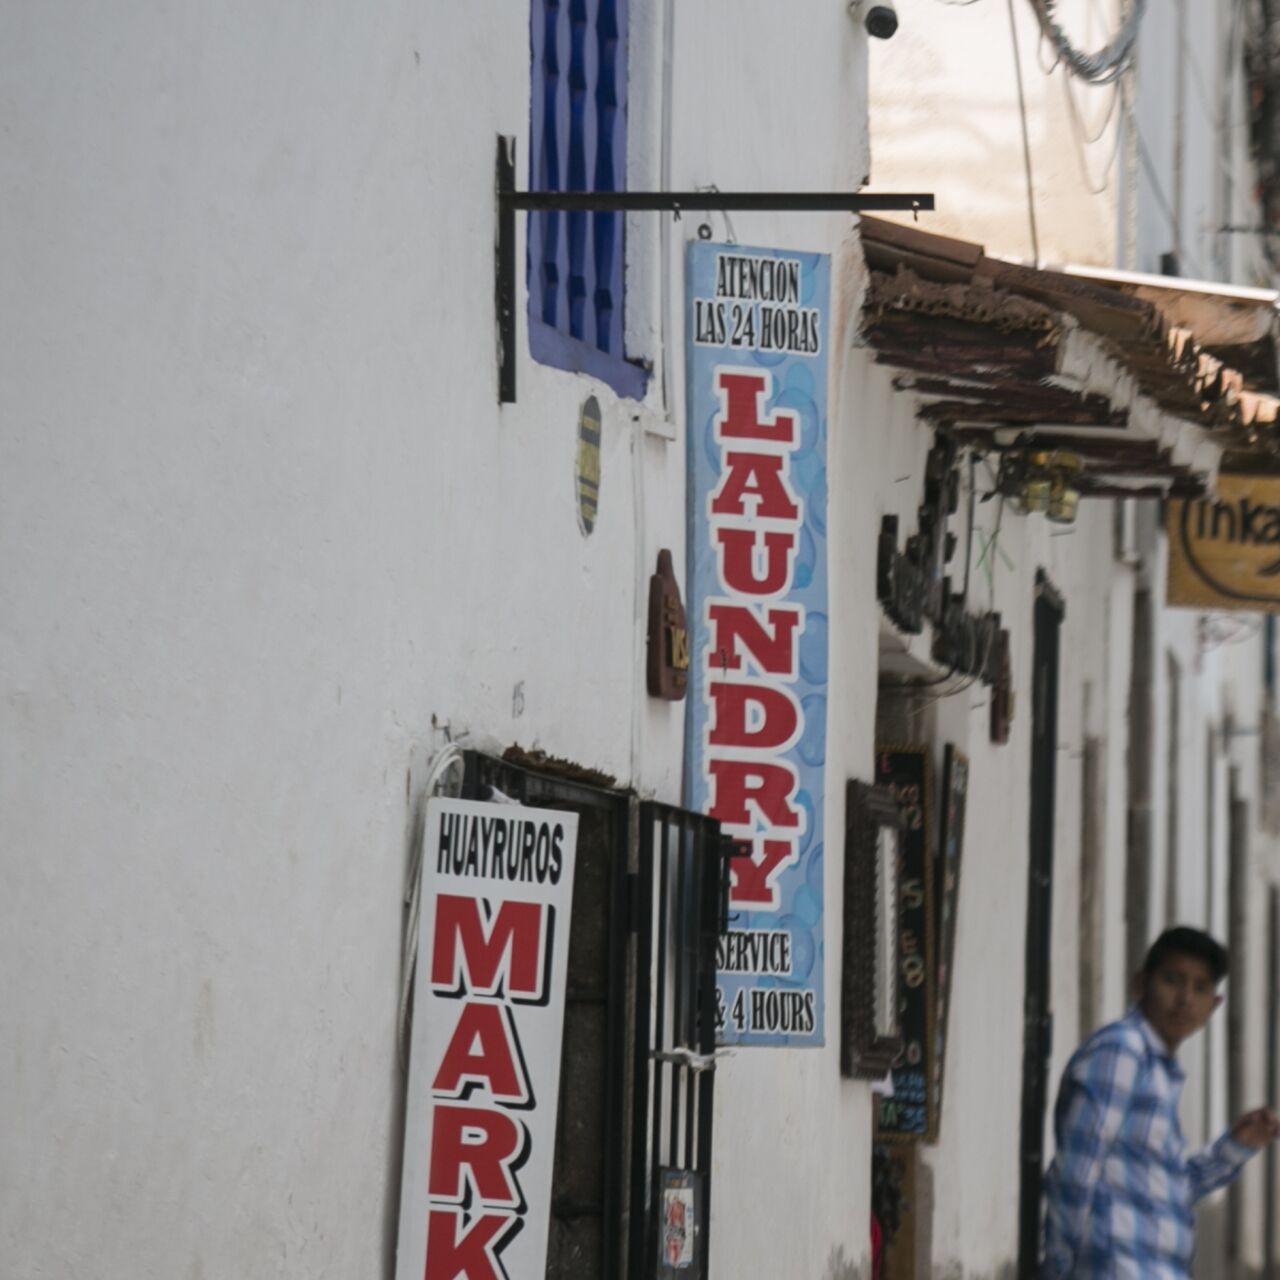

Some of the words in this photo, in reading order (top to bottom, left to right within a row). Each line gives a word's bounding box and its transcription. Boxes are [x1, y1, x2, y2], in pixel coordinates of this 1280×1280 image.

[716, 256, 799, 303] ATENCION
[696, 301, 726, 344] LAS
[732, 304, 755, 347] 24
[760, 307, 818, 353] HORAS
[708, 373, 800, 903] LAUNDRY
[436, 811, 565, 886] HUAYRUROS
[716, 931, 791, 973] SERVICE
[751, 990, 814, 1032] HOURS
